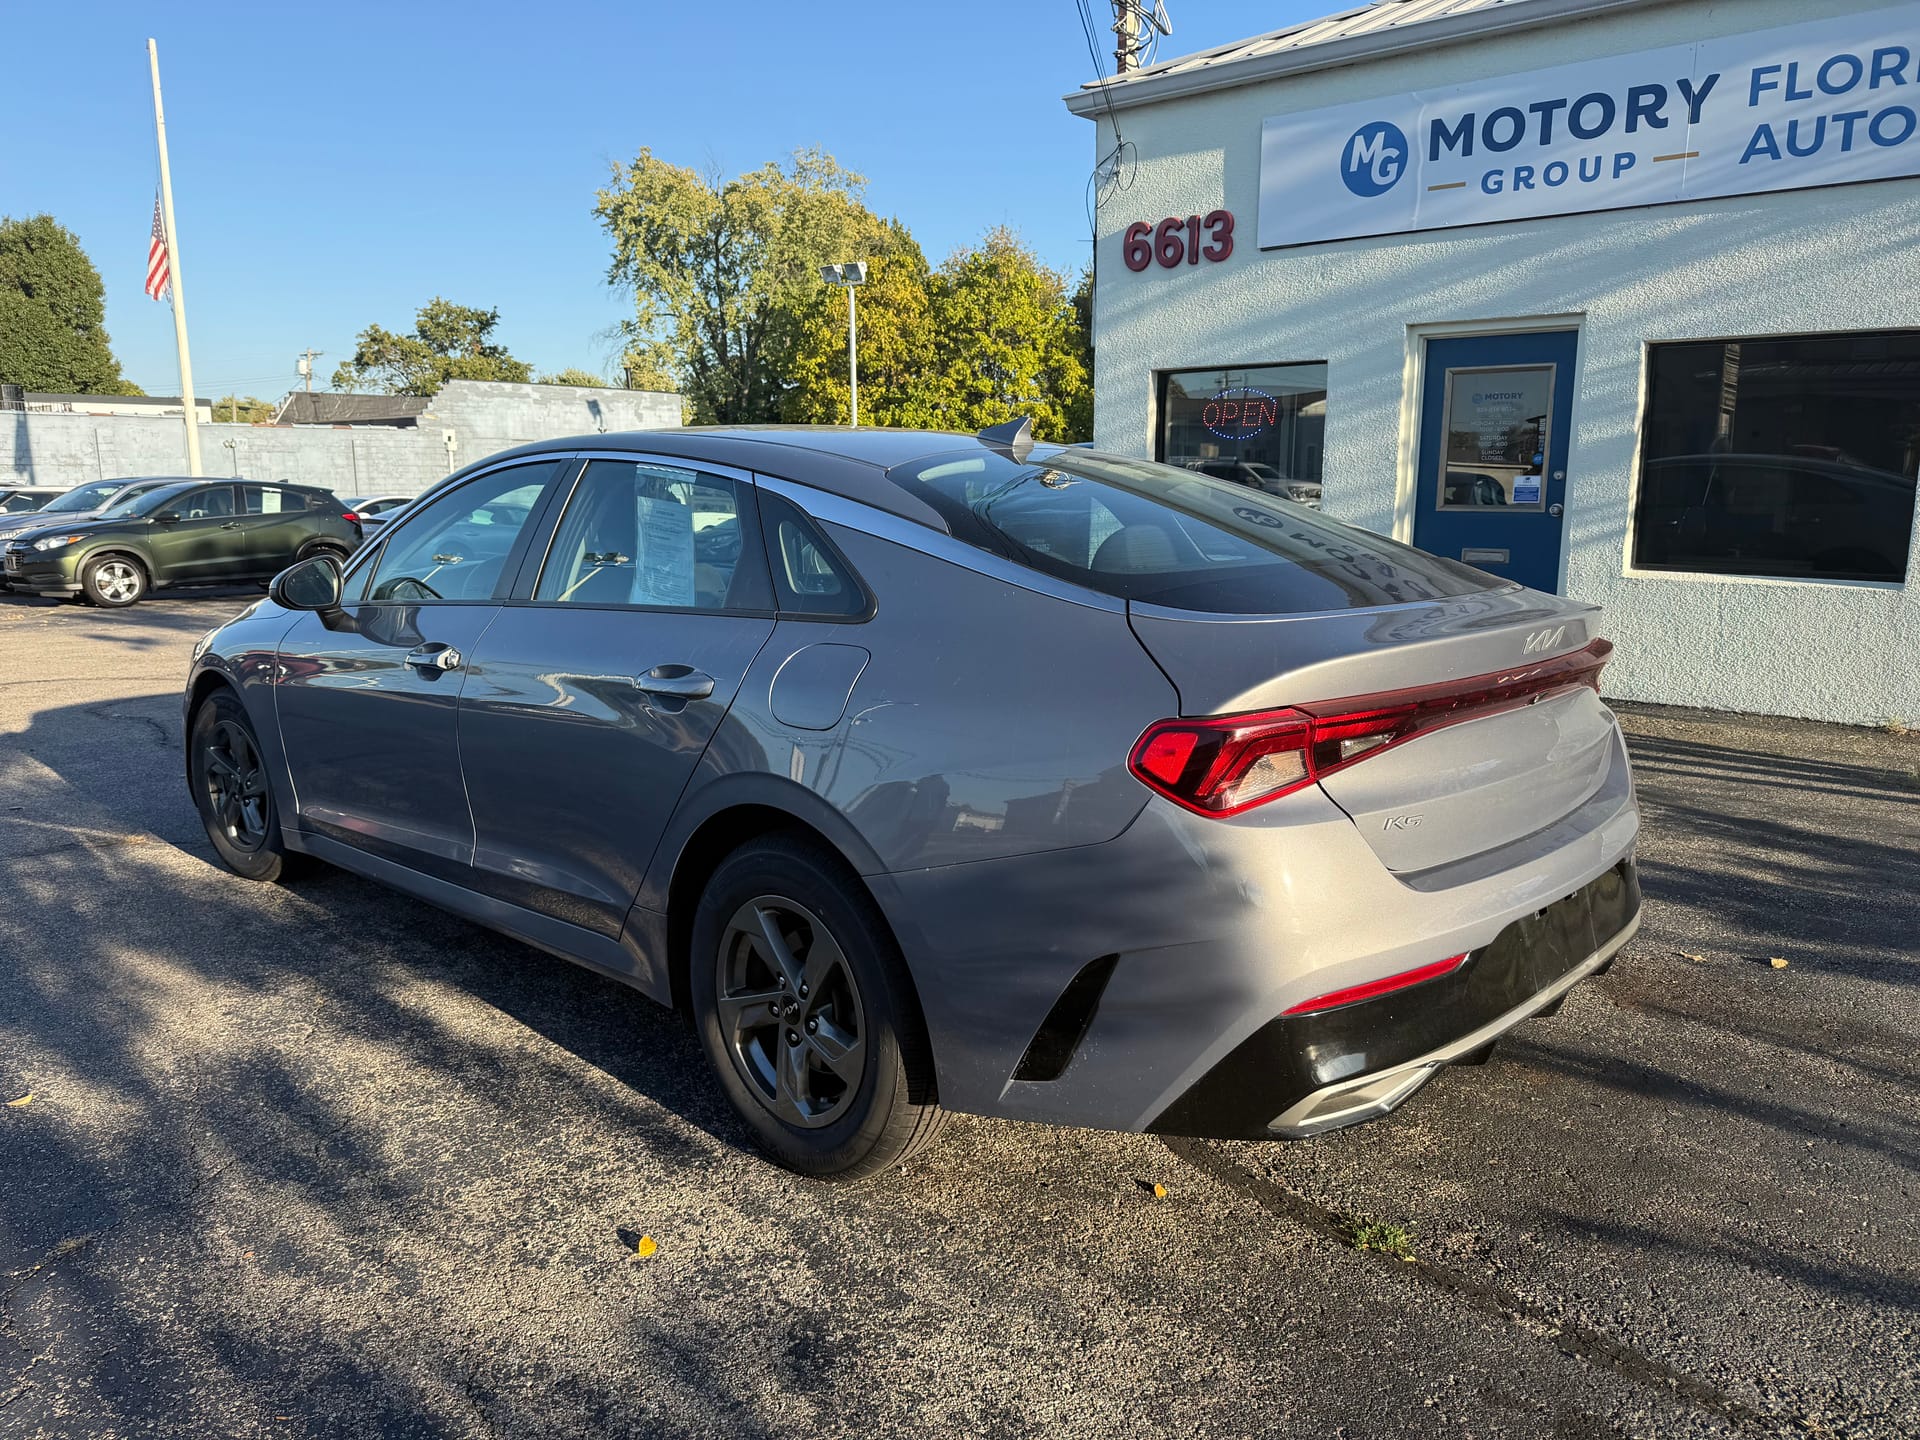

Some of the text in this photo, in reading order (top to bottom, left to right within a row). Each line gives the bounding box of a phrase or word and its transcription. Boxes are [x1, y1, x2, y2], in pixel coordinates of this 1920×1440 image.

[1748, 46, 1920, 107] FLOR
[1428, 73, 1720, 162] MOTORY
[1738, 105, 1918, 165] AUTO
[1348, 130, 1400, 186] MG
[1480, 151, 1637, 195] GROUP
[1123, 209, 1235, 273] 6613
[1202, 400, 1278, 428] OPEN
[1484, 392, 1523, 400] MOTORY
[1383, 814, 1424, 831] K5
